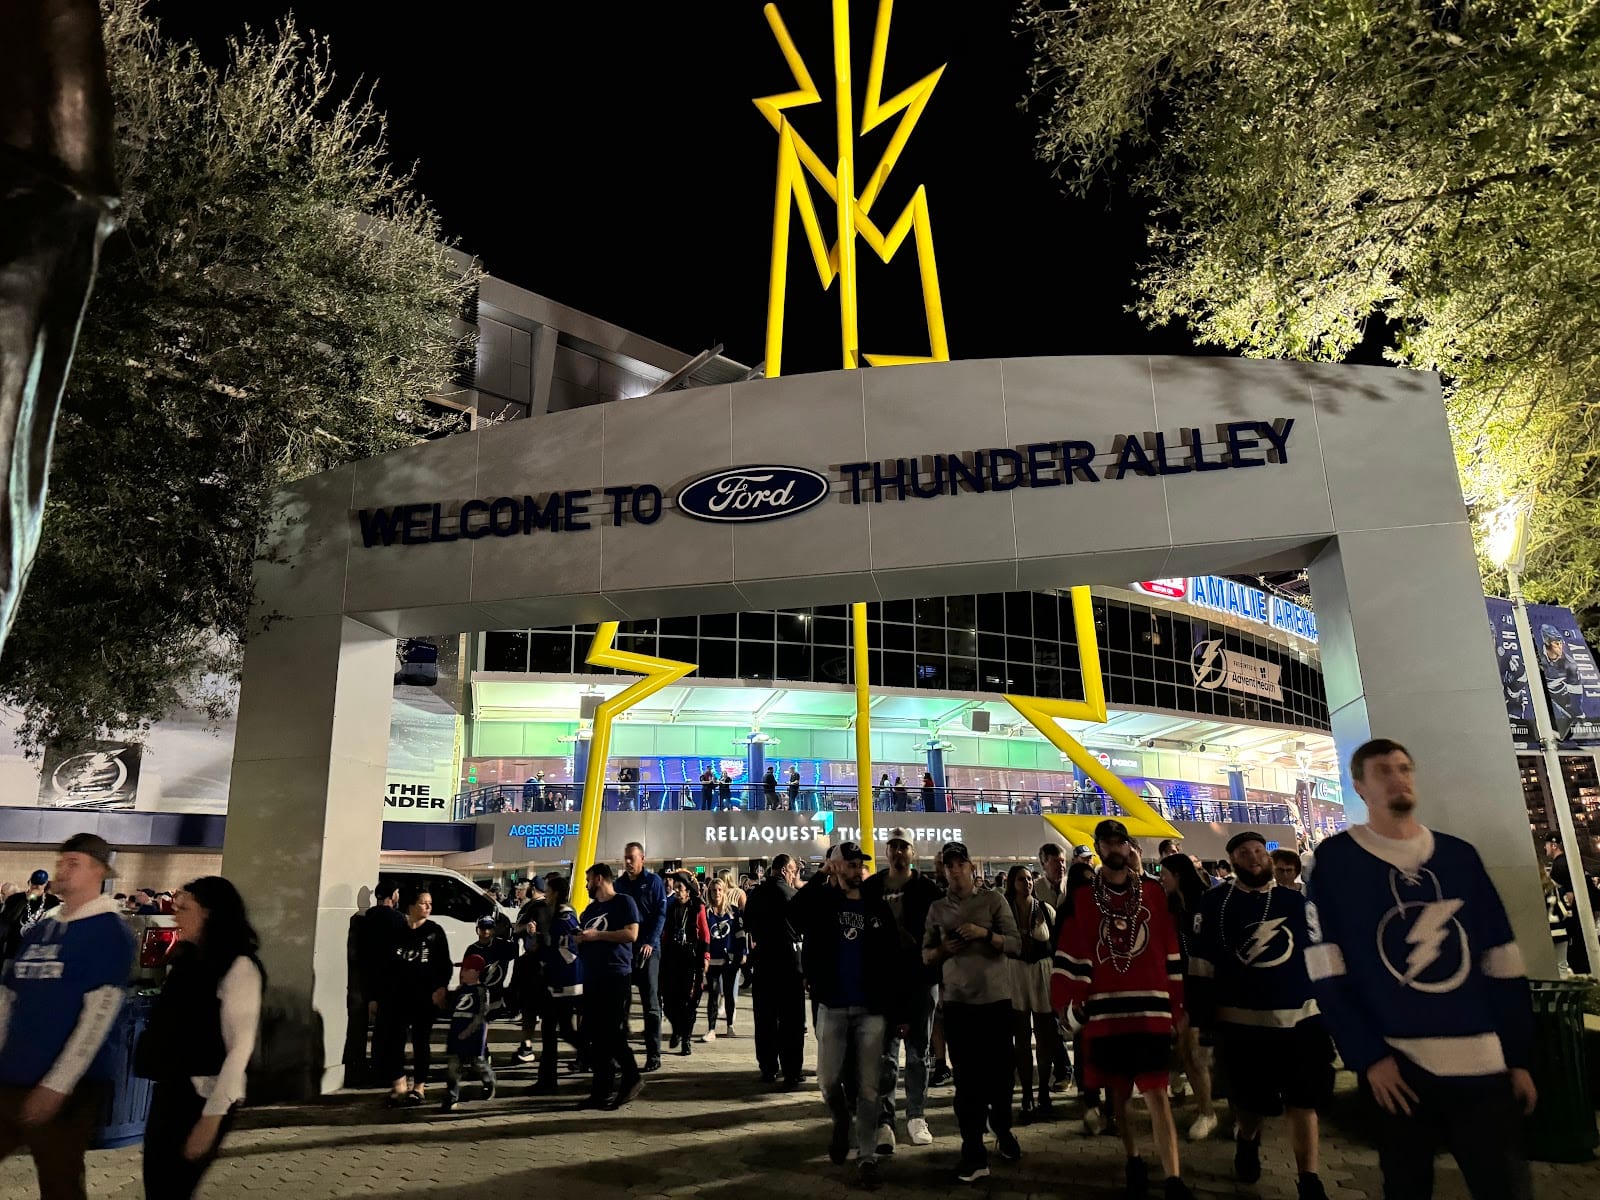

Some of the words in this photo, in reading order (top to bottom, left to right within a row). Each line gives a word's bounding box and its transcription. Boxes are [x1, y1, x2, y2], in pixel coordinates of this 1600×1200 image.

[358, 489, 592, 548] WELCOME
[603, 484, 662, 526] TO
[709, 474, 796, 511] Ford
[840, 440, 1100, 504] THUNDER
[1116, 418, 1295, 480] ALLEY
[1194, 575, 1268, 623] AMALIE
[1274, 596, 1319, 641] ARENA
[387, 783, 430, 795] THE
[509, 823, 580, 837] ACCESSIBLE
[705, 826, 821, 842] RELIAQUEST
[526, 836, 565, 848] ENTRY
